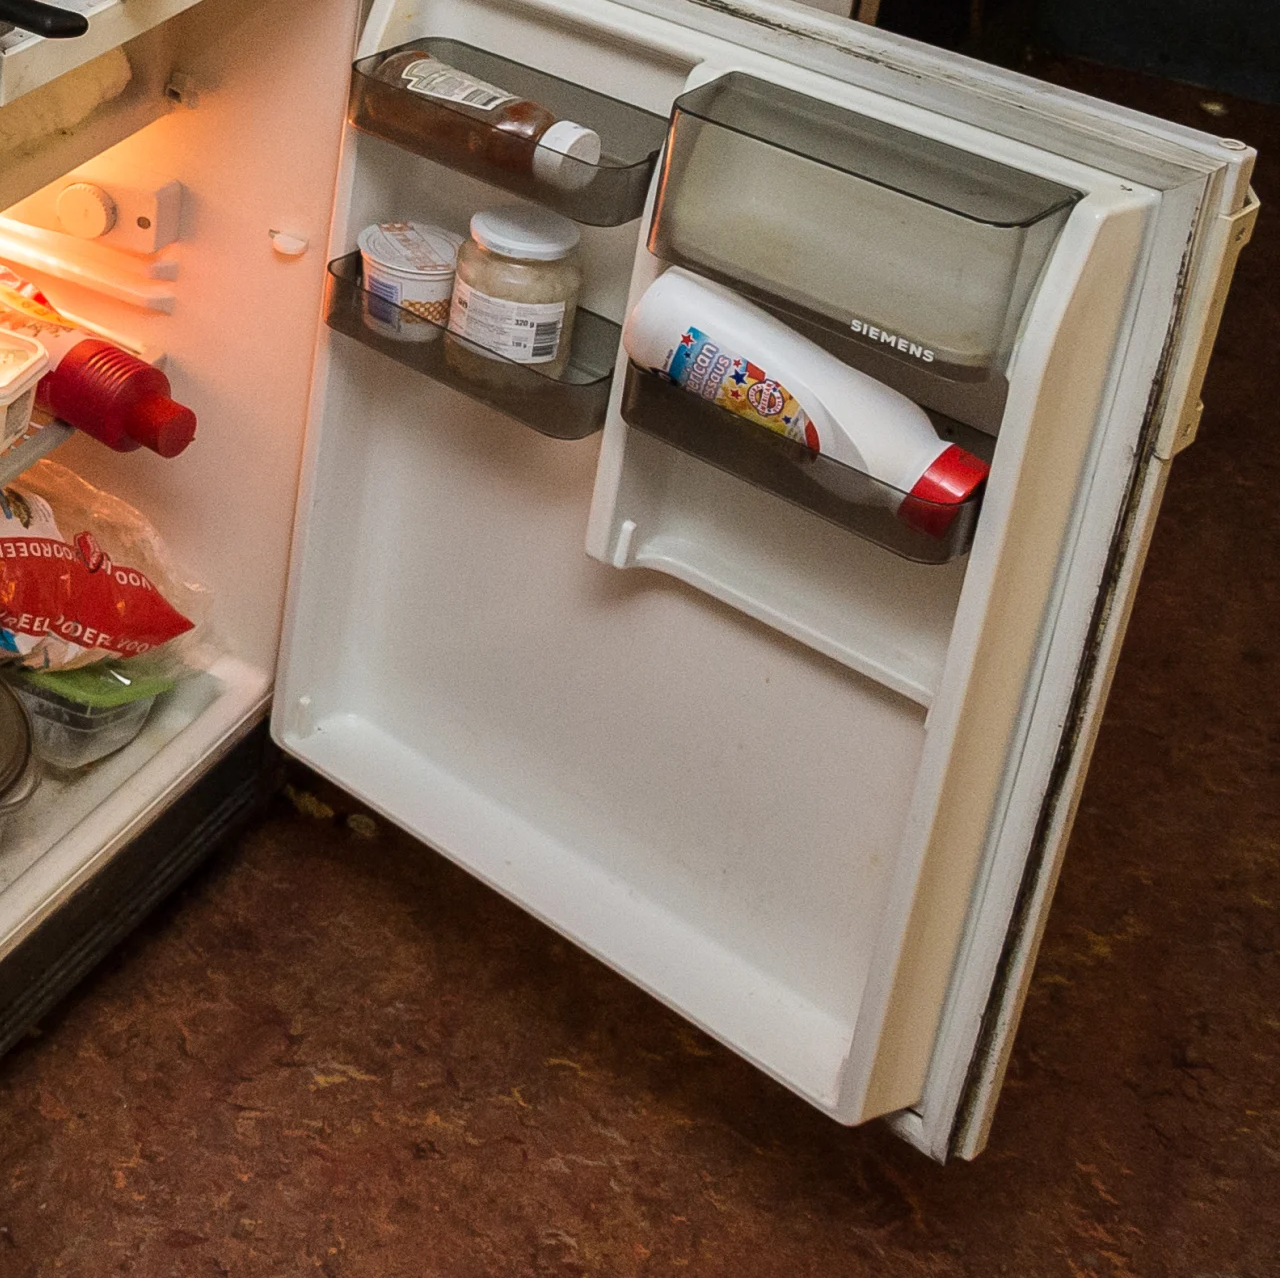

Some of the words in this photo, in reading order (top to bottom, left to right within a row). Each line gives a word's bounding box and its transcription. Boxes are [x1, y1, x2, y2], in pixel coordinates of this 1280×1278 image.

[850, 319, 935, 363] SIEMENS
[685, 342, 718, 393] erican
[702, 355, 731, 401] essaus
